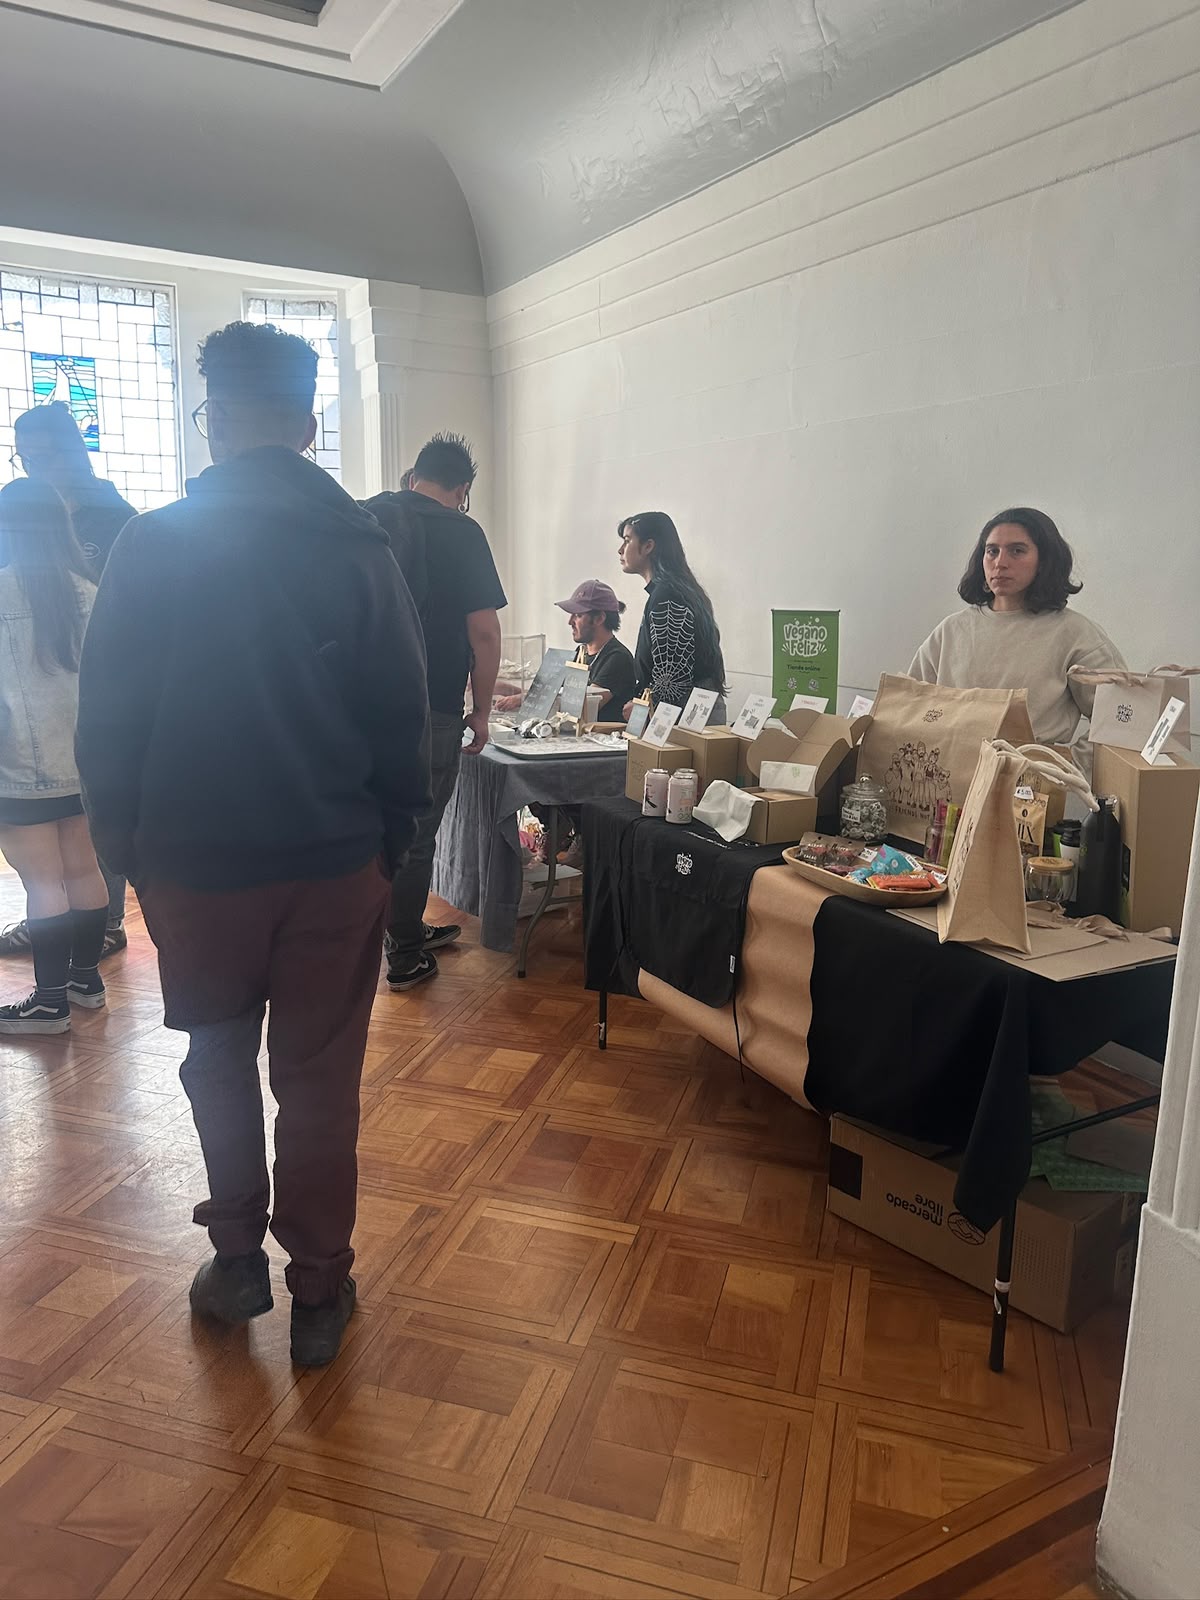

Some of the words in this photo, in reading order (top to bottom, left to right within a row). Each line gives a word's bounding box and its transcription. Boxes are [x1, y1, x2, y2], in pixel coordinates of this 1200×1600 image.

[784, 624, 827, 641] Vegano
[790, 640, 818, 656] Feliz
[886, 1193, 942, 1226] mercado
[915, 1194, 943, 1217] libre
